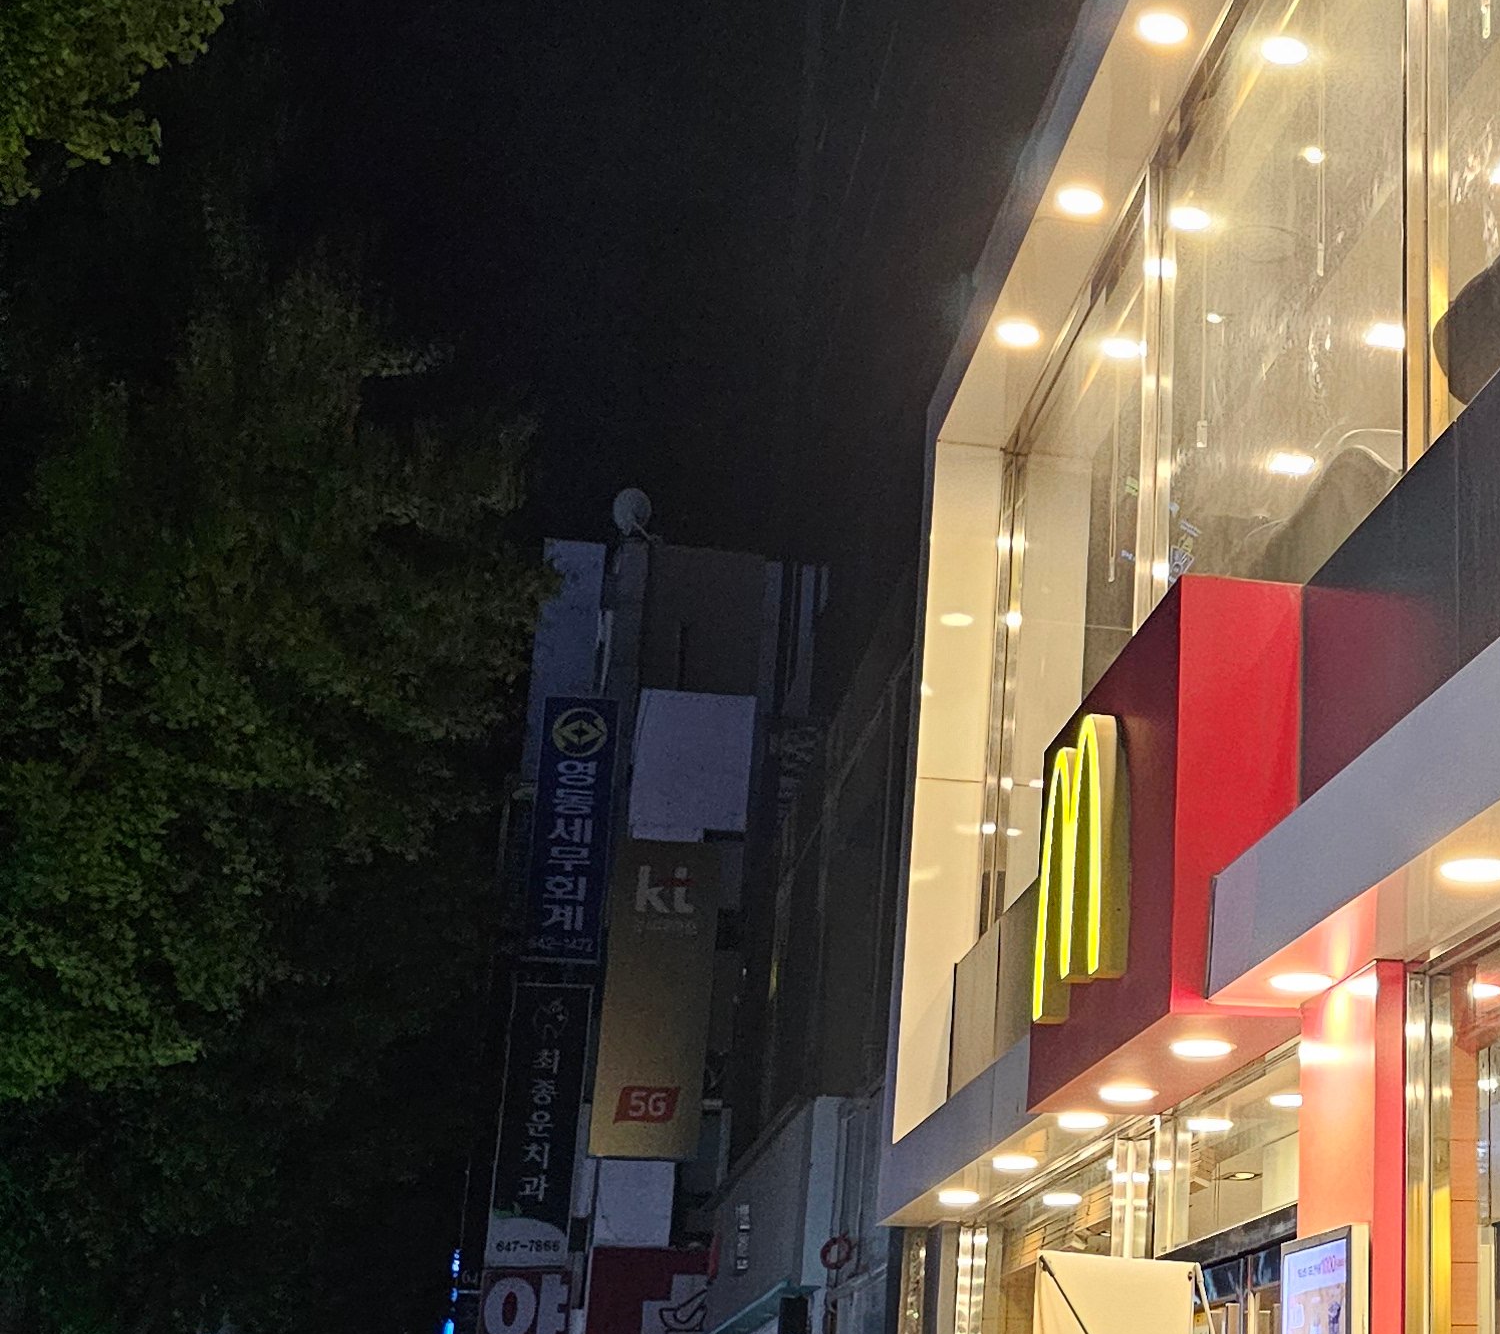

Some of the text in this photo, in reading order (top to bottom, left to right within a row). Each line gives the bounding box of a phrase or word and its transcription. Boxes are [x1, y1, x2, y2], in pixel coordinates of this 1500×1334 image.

[541, 760, 599, 931] 영동세무회계
[634, 865, 696, 913] kt
[628, 1090, 669, 1118] 5G
